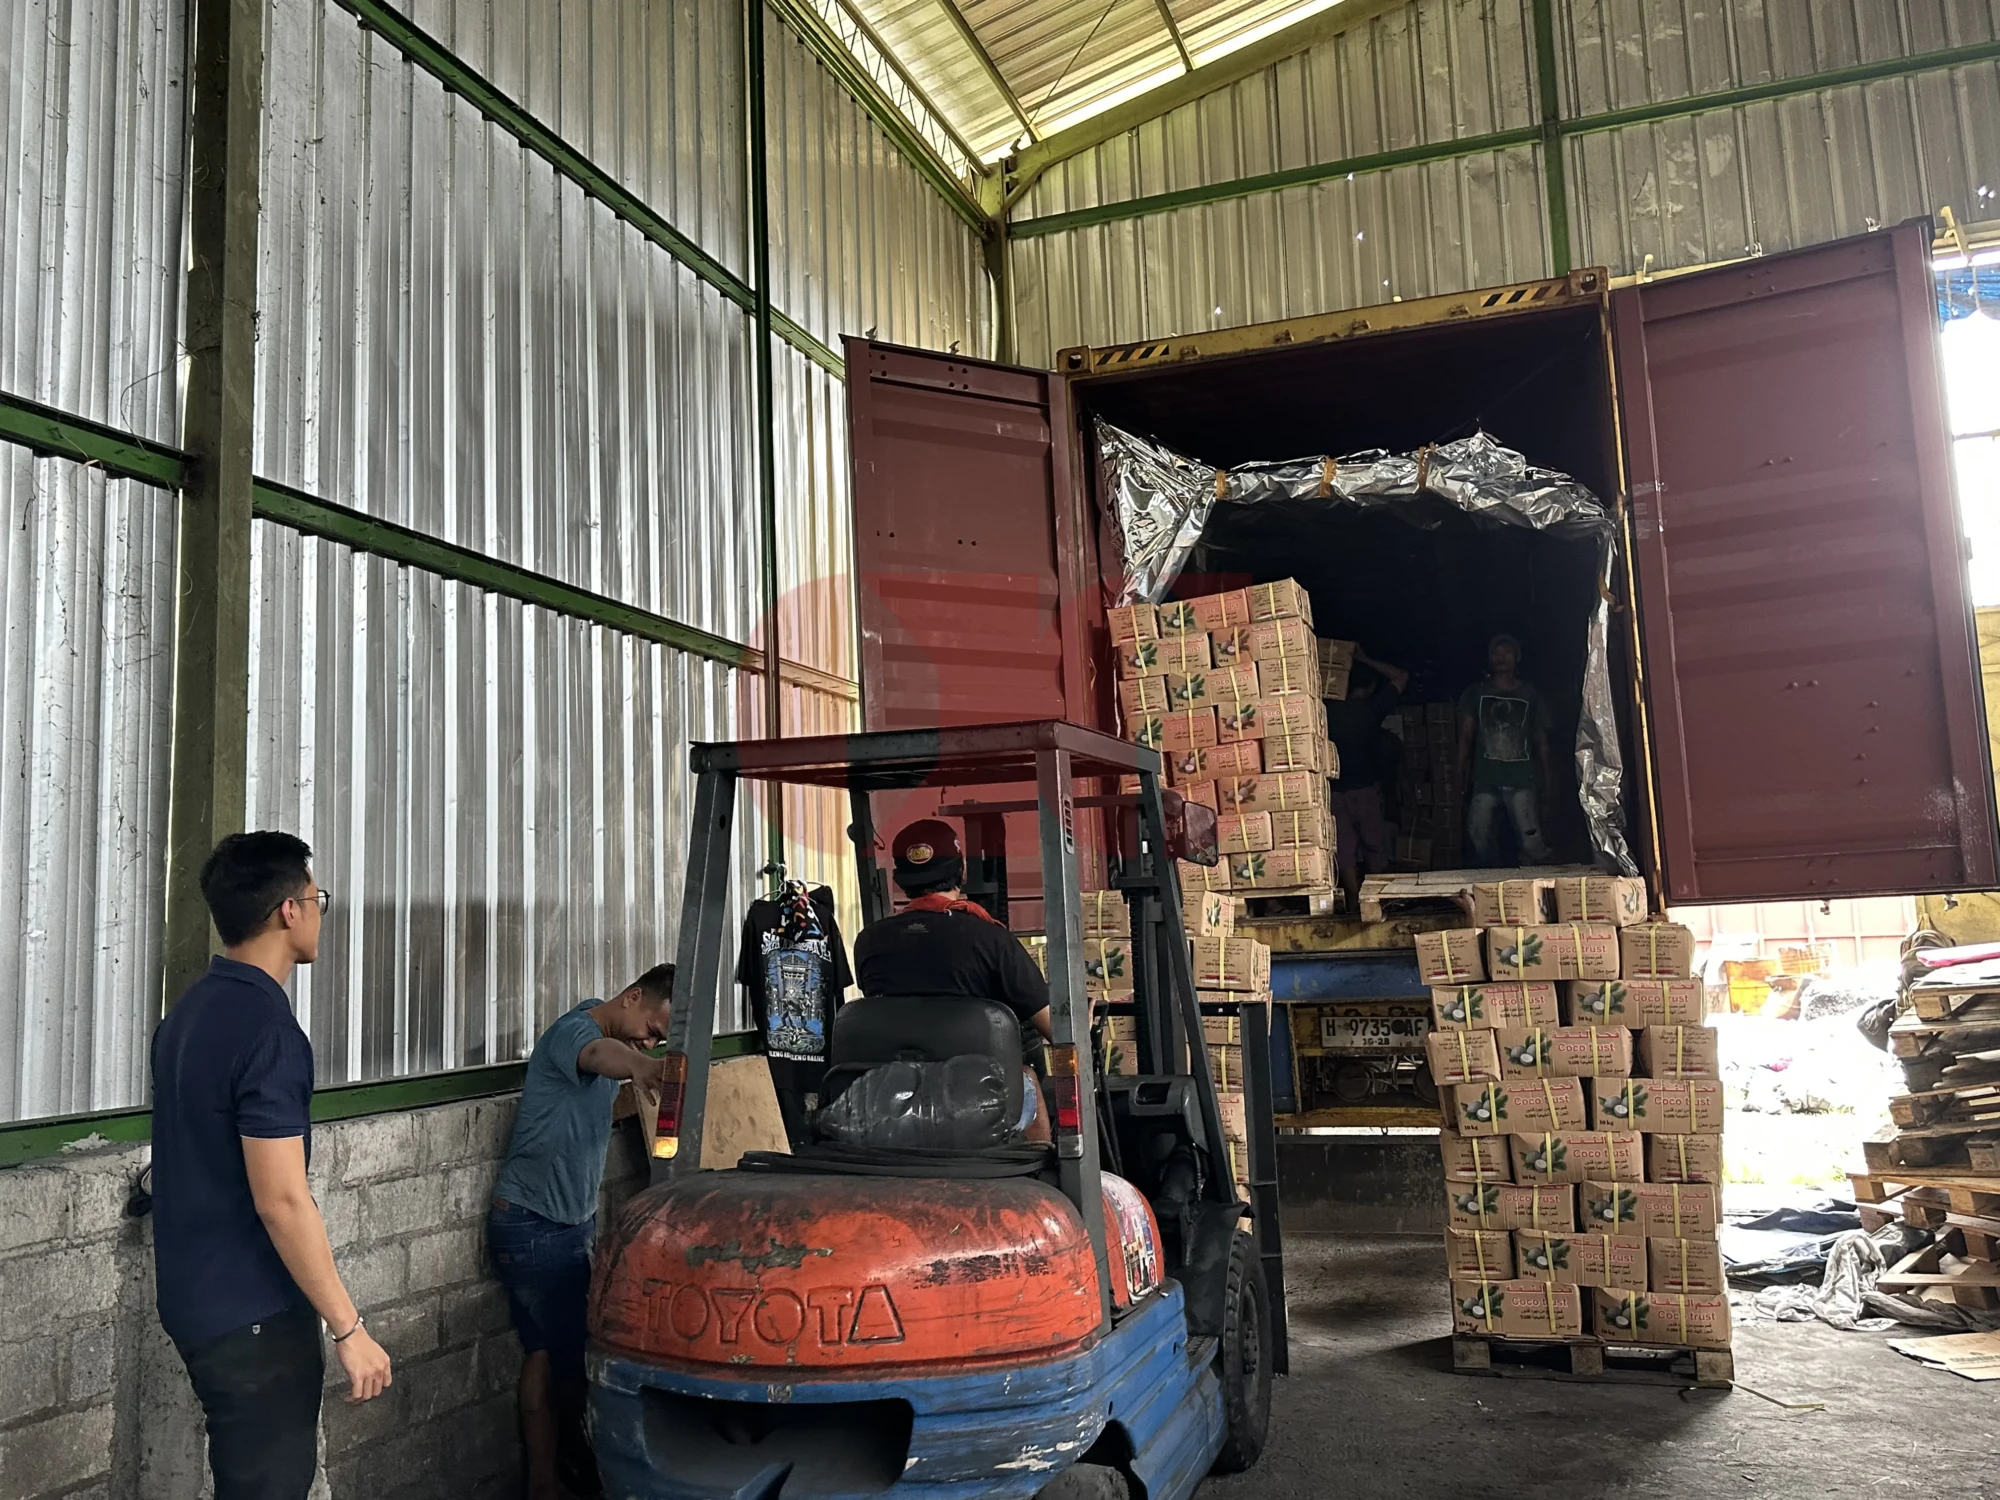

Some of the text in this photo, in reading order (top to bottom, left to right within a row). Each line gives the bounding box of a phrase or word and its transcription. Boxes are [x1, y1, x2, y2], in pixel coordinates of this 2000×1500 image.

[1551, 945, 1606, 953] Coco trust
[1491, 996, 1544, 1006] Coco tust
[1633, 994, 1688, 1002] Coco rust
[1326, 1018, 1424, 1036] H 9735 AF
[1559, 1043, 1615, 1052] Coco tust
[1514, 1094, 1570, 1106] Coco tust
[1654, 1097, 1710, 1105] Coco tust
[1221, 1108, 1234, 1116] ust
[1573, 1148, 1629, 1157] Coco tust
[1505, 1193, 1559, 1203] Coco rust
[1645, 1202, 1702, 1212] Coco rust
[1578, 1251, 1634, 1262] Coco trust
[1512, 1297, 1568, 1307] Coco tust
[641, 1277, 905, 1346] TOYOTA
[1658, 1310, 1715, 1320] Coc trust
